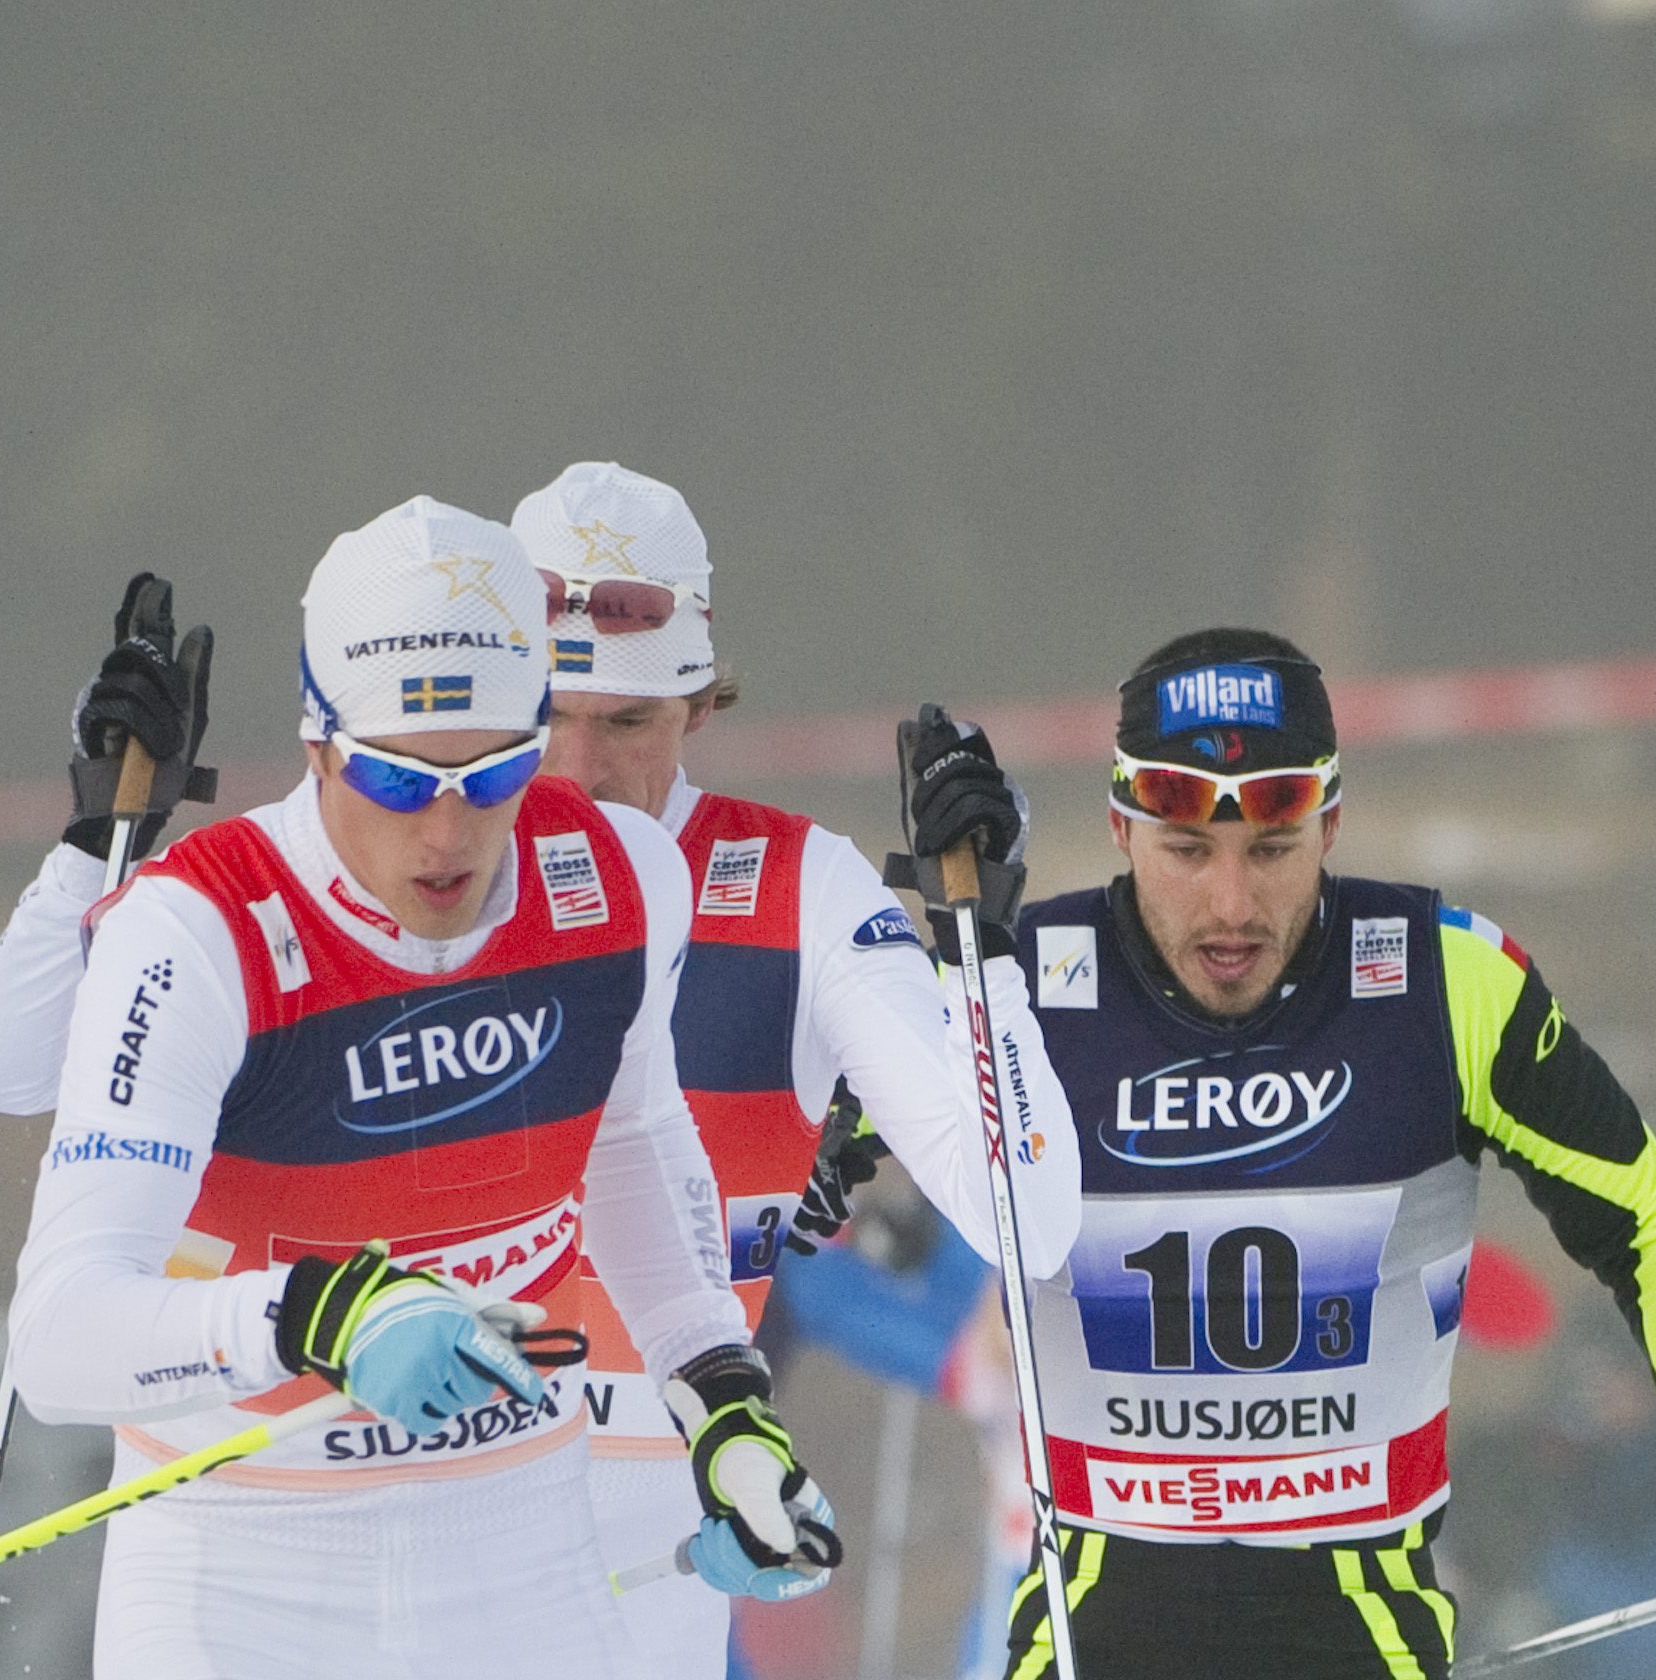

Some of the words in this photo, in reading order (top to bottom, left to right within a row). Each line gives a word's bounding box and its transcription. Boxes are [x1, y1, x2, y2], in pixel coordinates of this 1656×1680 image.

[344, 631, 505, 661] VATTENFALL
[1165, 670, 1277, 719] Villard
[1218, 702, 1240, 721] de
[544, 857, 592, 873] CROSS
[712, 856, 759, 870] CROSS
[1355, 936, 1403, 949] CROSS
[109, 983, 159, 1107] CRAFT
[344, 1005, 548, 1103] LERØY
[1115, 1069, 1335, 1132] LERØY
[749, 1205, 782, 1270] 3
[1122, 1226, 1301, 1371] 10
[1315, 1296, 1354, 1358] 3
[470, 1329, 533, 1393] HESTRA
[1105, 1392, 1357, 1442] SJUSJØEN
[1104, 1461, 1371, 1522] VIESSMANN
